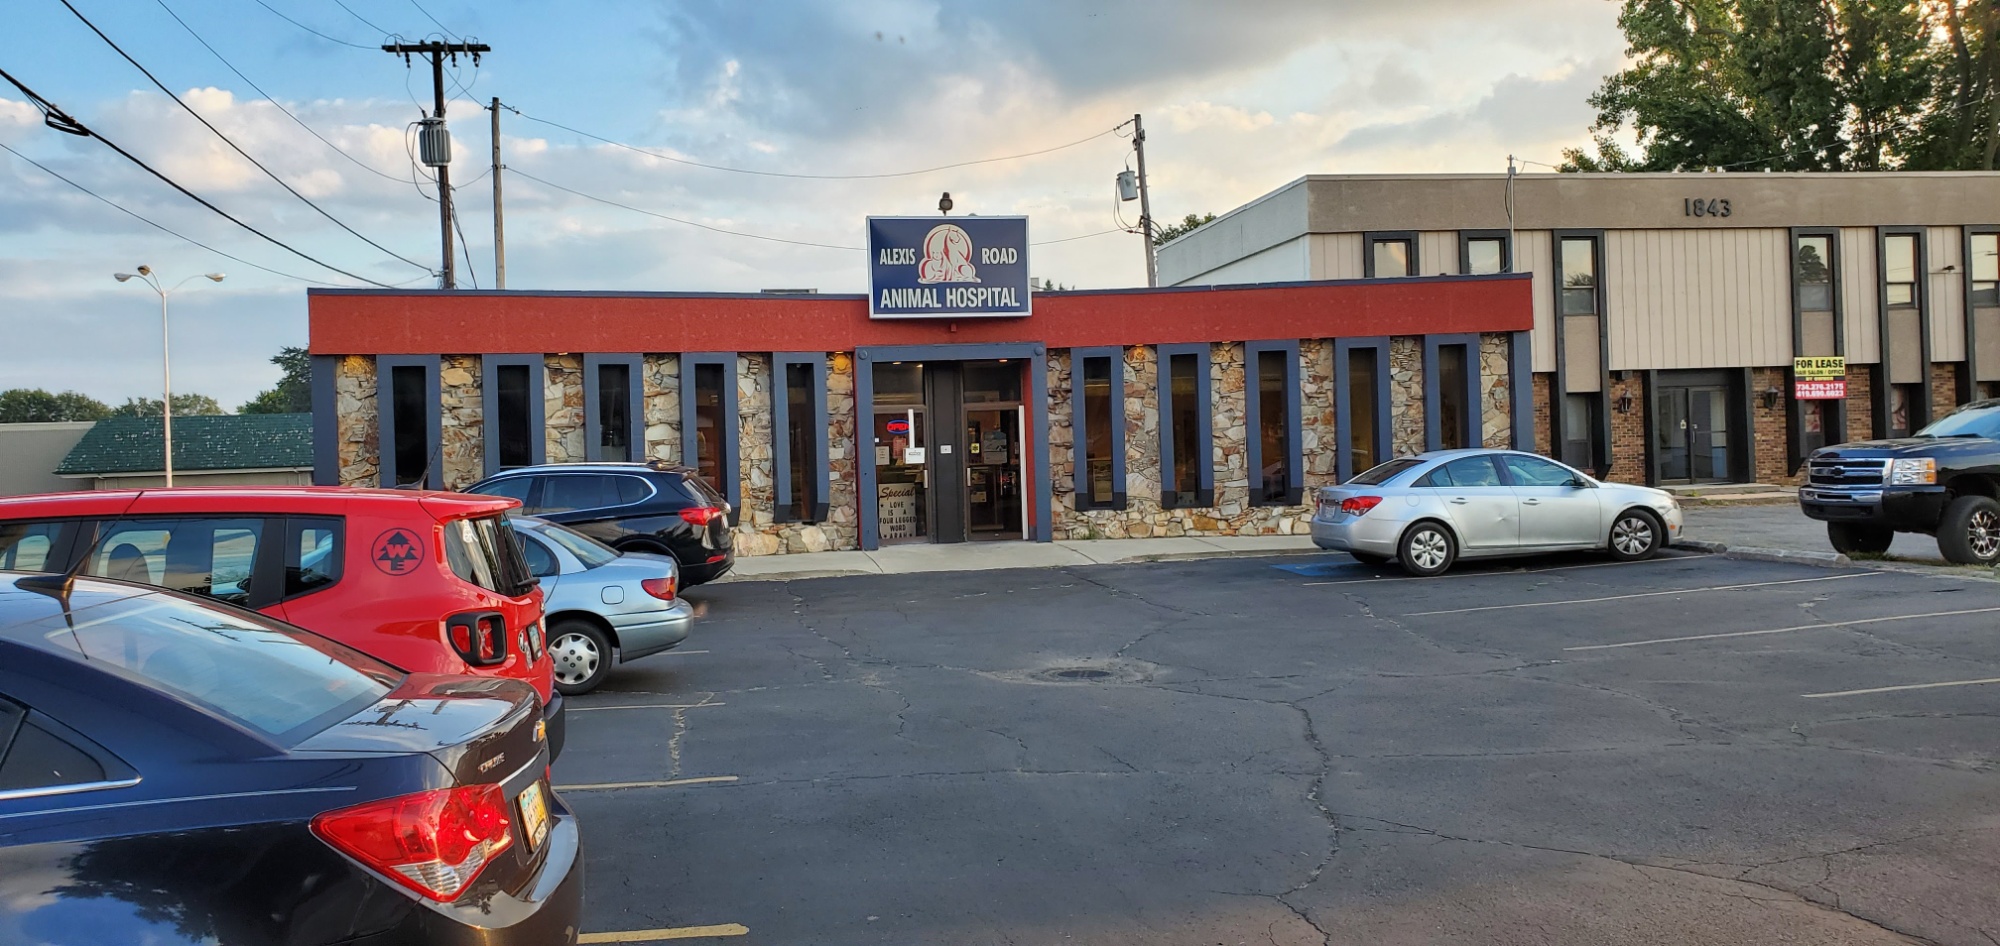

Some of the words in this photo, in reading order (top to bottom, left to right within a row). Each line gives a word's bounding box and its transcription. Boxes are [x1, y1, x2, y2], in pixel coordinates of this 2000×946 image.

[1684, 198, 1732, 217] 1843
[879, 248, 916, 266] ALEXIS
[981, 247, 1018, 265] ROAD
[880, 287, 942, 309] ANIMAL
[945, 286, 1021, 309] HOSPITAL
[1795, 359, 1813, 369] FOR
[1815, 359, 1844, 369] LEASE
[879, 486, 915, 500] Special
[889, 501, 904, 509] LOVE
[887, 509, 894, 517] IS
[895, 516, 917, 524] LEGGED
[889, 524, 907, 532] WORD
